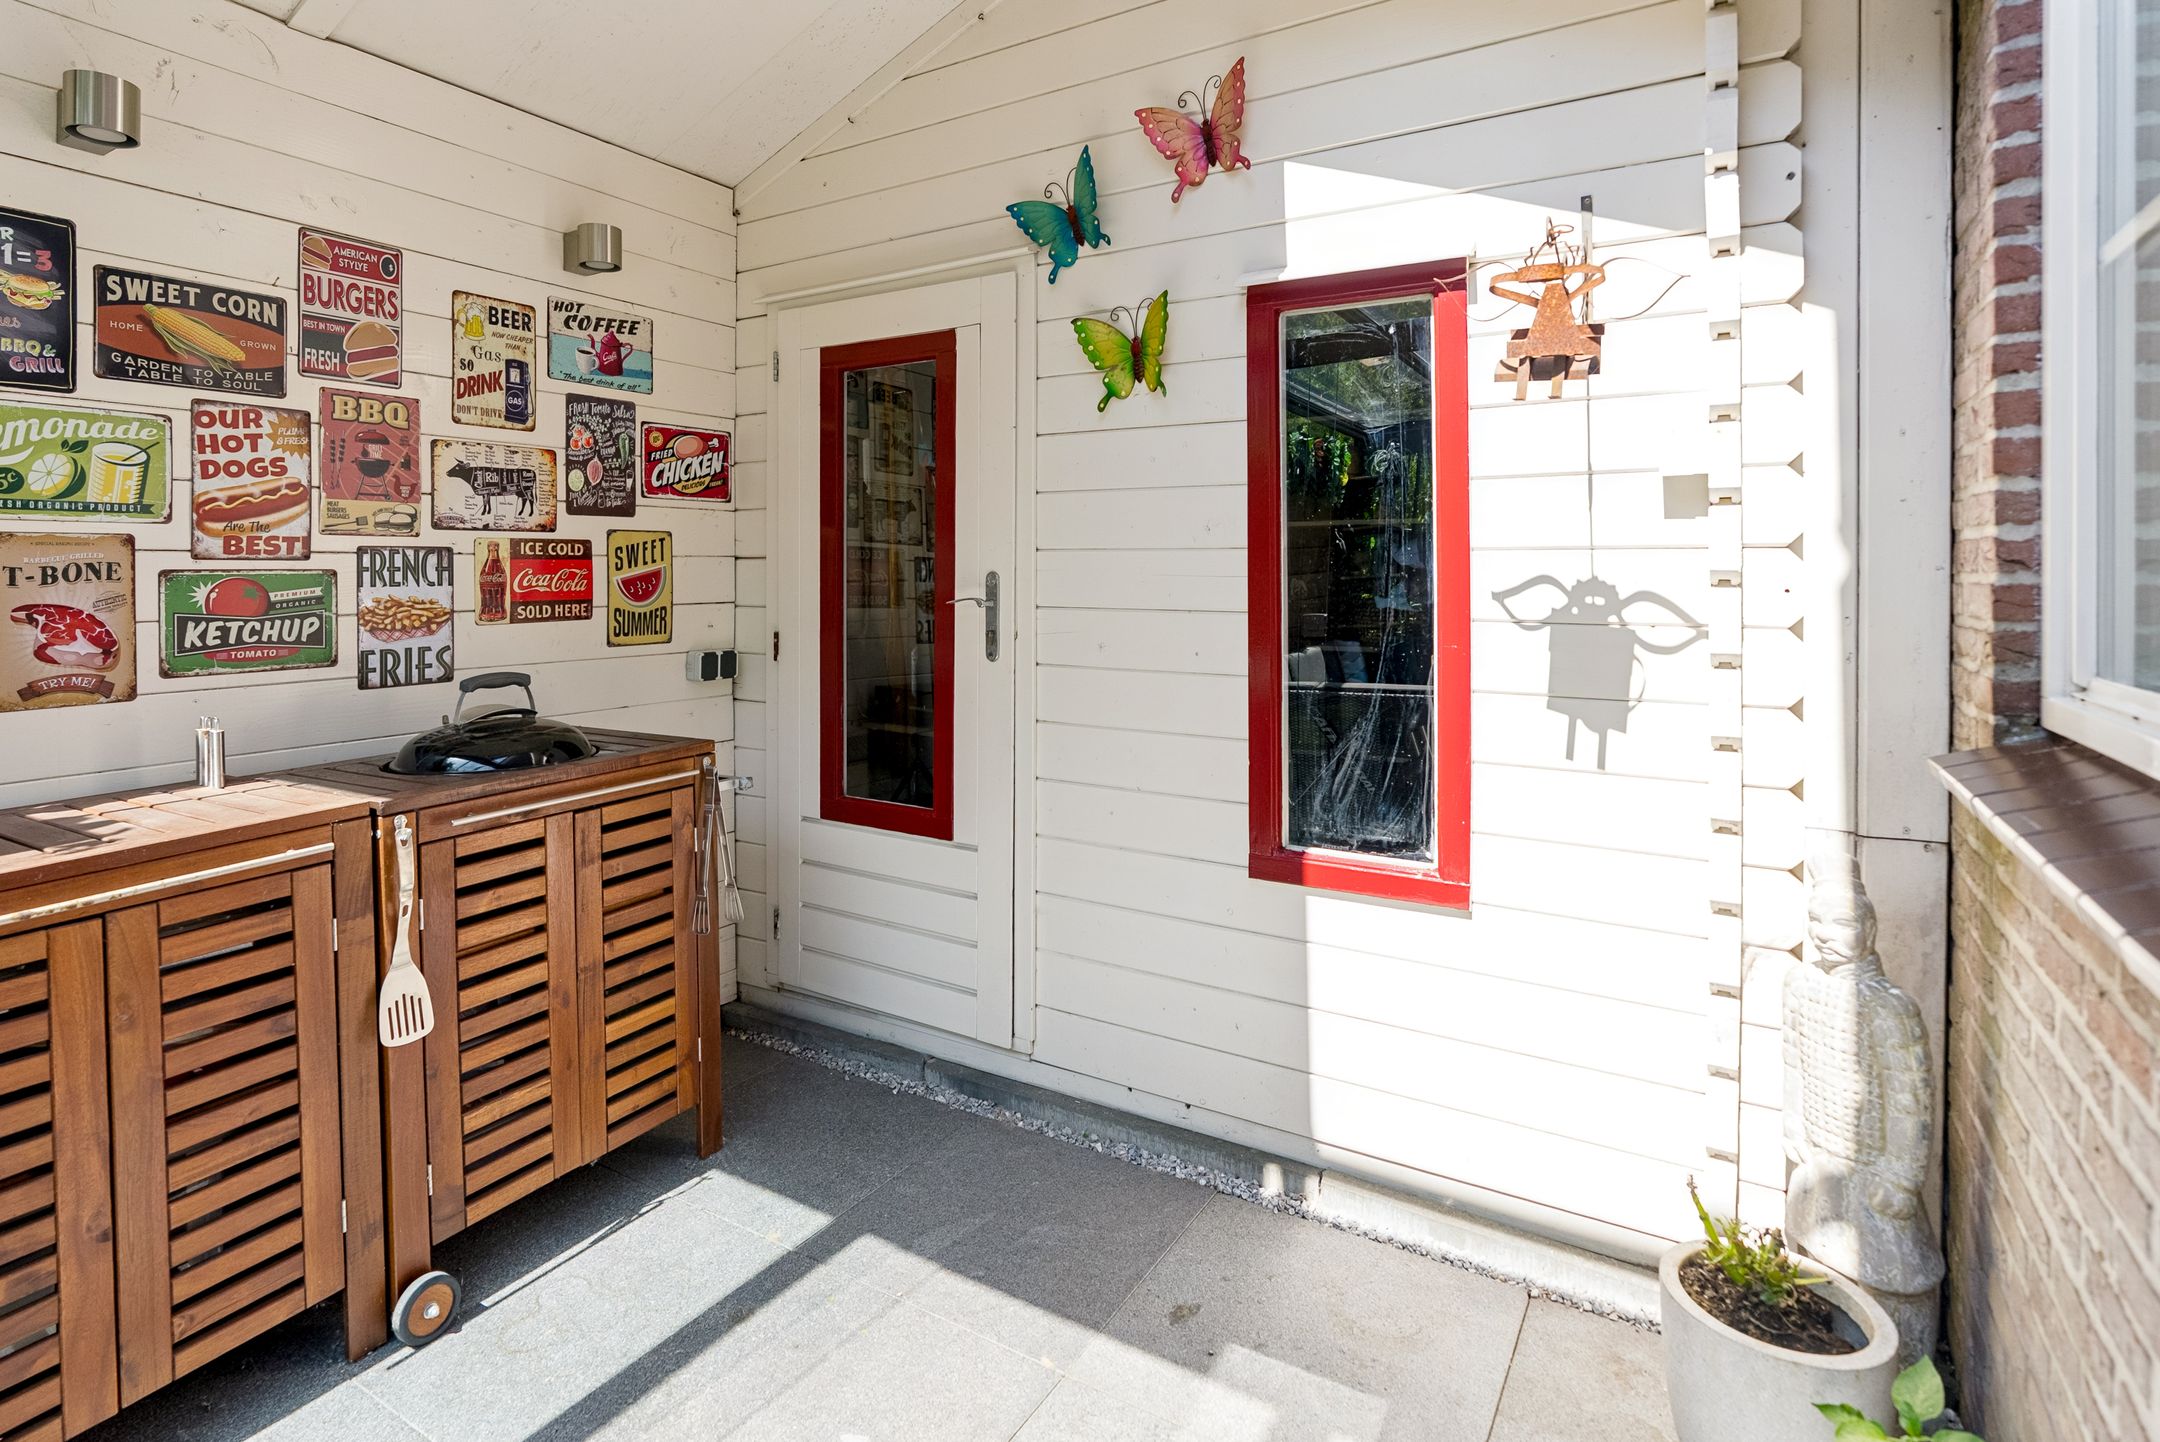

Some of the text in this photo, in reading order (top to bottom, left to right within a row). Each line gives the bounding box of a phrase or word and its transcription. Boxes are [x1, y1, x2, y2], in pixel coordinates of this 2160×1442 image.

[333, 245, 378, 263] AMERICAN
[106, 274, 278, 327] SWEET CORN
[303, 273, 400, 321] BURGERS
[553, 300, 585, 314] HOT
[109, 320, 143, 332] HOME
[303, 319, 346, 334] BEST IN TOWN
[488, 305, 532, 332] BEER
[563, 314, 641, 336] COFFEE
[0, 337, 42, 357] BBQ
[240, 339, 277, 351] GROWN
[491, 331, 534, 344] NOW CHEAPER
[505, 342, 521, 351] THAN
[9, 355, 65, 374] GRILL
[111, 352, 273, 381] GARDEN TO TABLE
[304, 347, 340, 372] FRESH
[125, 366, 262, 391] TABLE TO SOUL
[456, 369, 504, 400] DRINK
[596, 379, 615, 387] drink
[617, 382, 626, 390] of
[507, 396, 522, 405] GAS
[194, 408, 264, 429] OUR
[331, 393, 410, 431] BBQ
[456, 404, 503, 419] DON'T DRIVE
[0, 417, 159, 450] monade
[196, 433, 263, 454] HOT
[650, 448, 673, 461] FRIED
[199, 456, 288, 480] DOGS
[485, 471, 499, 483] Rib
[651, 450, 724, 488] CHICKEN
[29, 501, 83, 511] ORGANIC
[90, 503, 142, 512] PRODUCT
[222, 520, 271, 533] Are The
[222, 535, 308, 556] BEST!
[520, 542, 584, 556] ICE COLD
[614, 538, 666, 571] SWEET
[69, 552, 104, 560] GRILLED
[2, 562, 123, 587] T-BONE
[359, 548, 453, 587] FRENCH
[513, 568, 589, 593] Coca-Cola
[273, 589, 316, 599] PREMIUM
[275, 600, 316, 609] ORGANIC
[517, 604, 587, 619] SOLD HERE
[613, 606, 668, 637] SUMMER
[184, 616, 320, 648] KETCHUP
[230, 649, 277, 659] TOMATO
[360, 645, 453, 688] FRIES
[38, 676, 96, 690] TRY ME!
